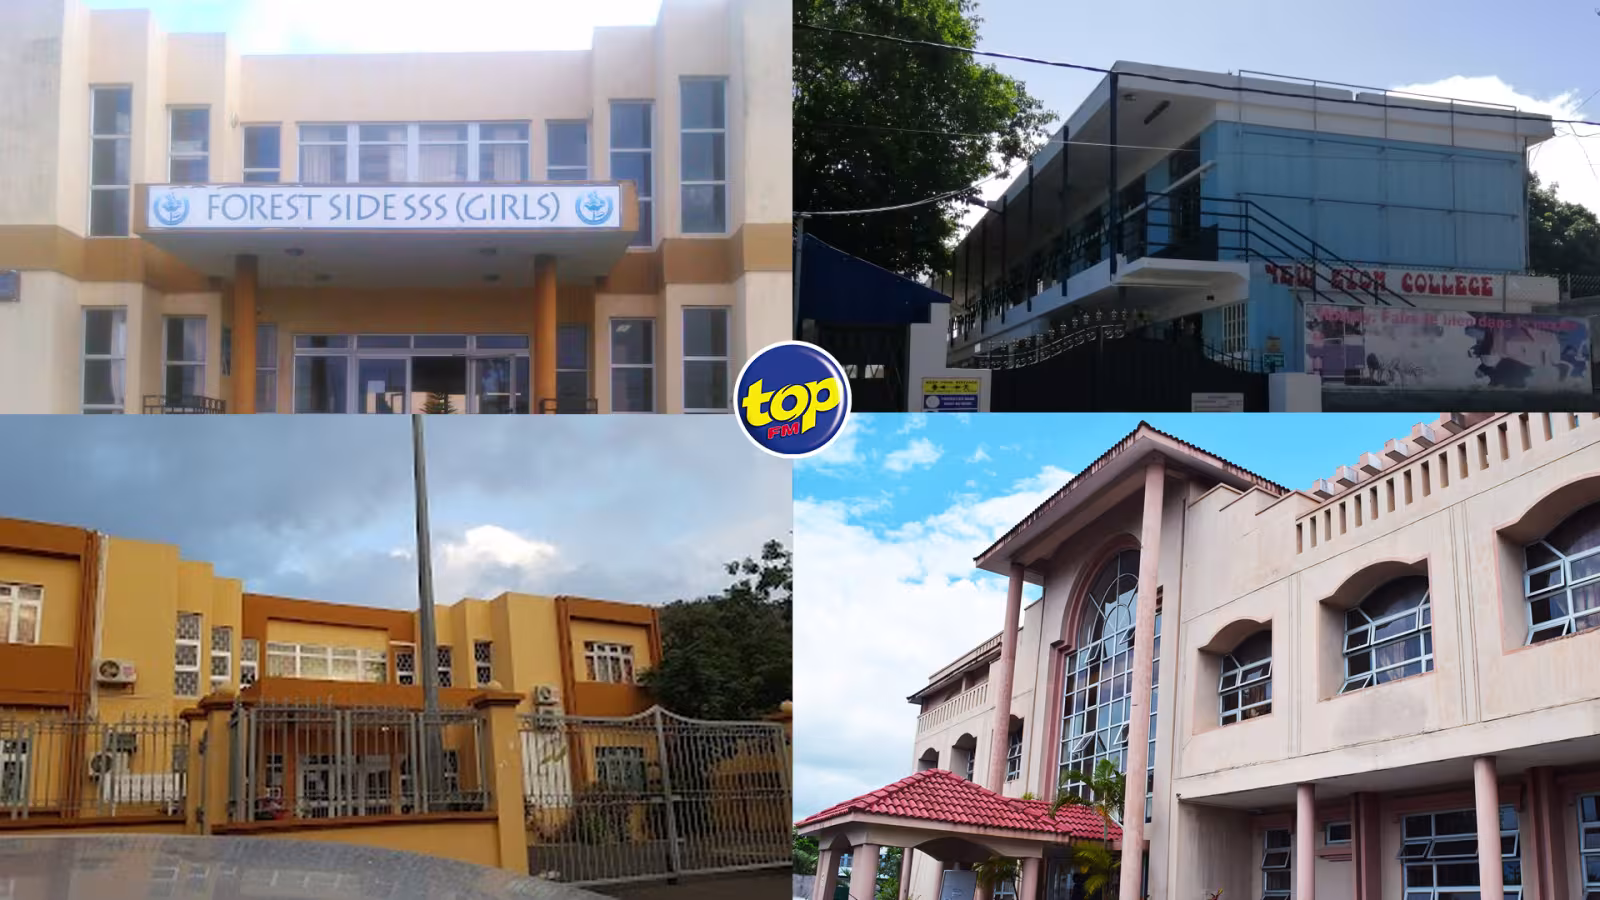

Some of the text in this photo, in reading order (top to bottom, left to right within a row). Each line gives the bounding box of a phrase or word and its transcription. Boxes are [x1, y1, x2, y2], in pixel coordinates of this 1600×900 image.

[207, 191, 561, 223] FOREST SIDE SSS (GIRLS)
[1401, 271, 1493, 297] COLLEGE
